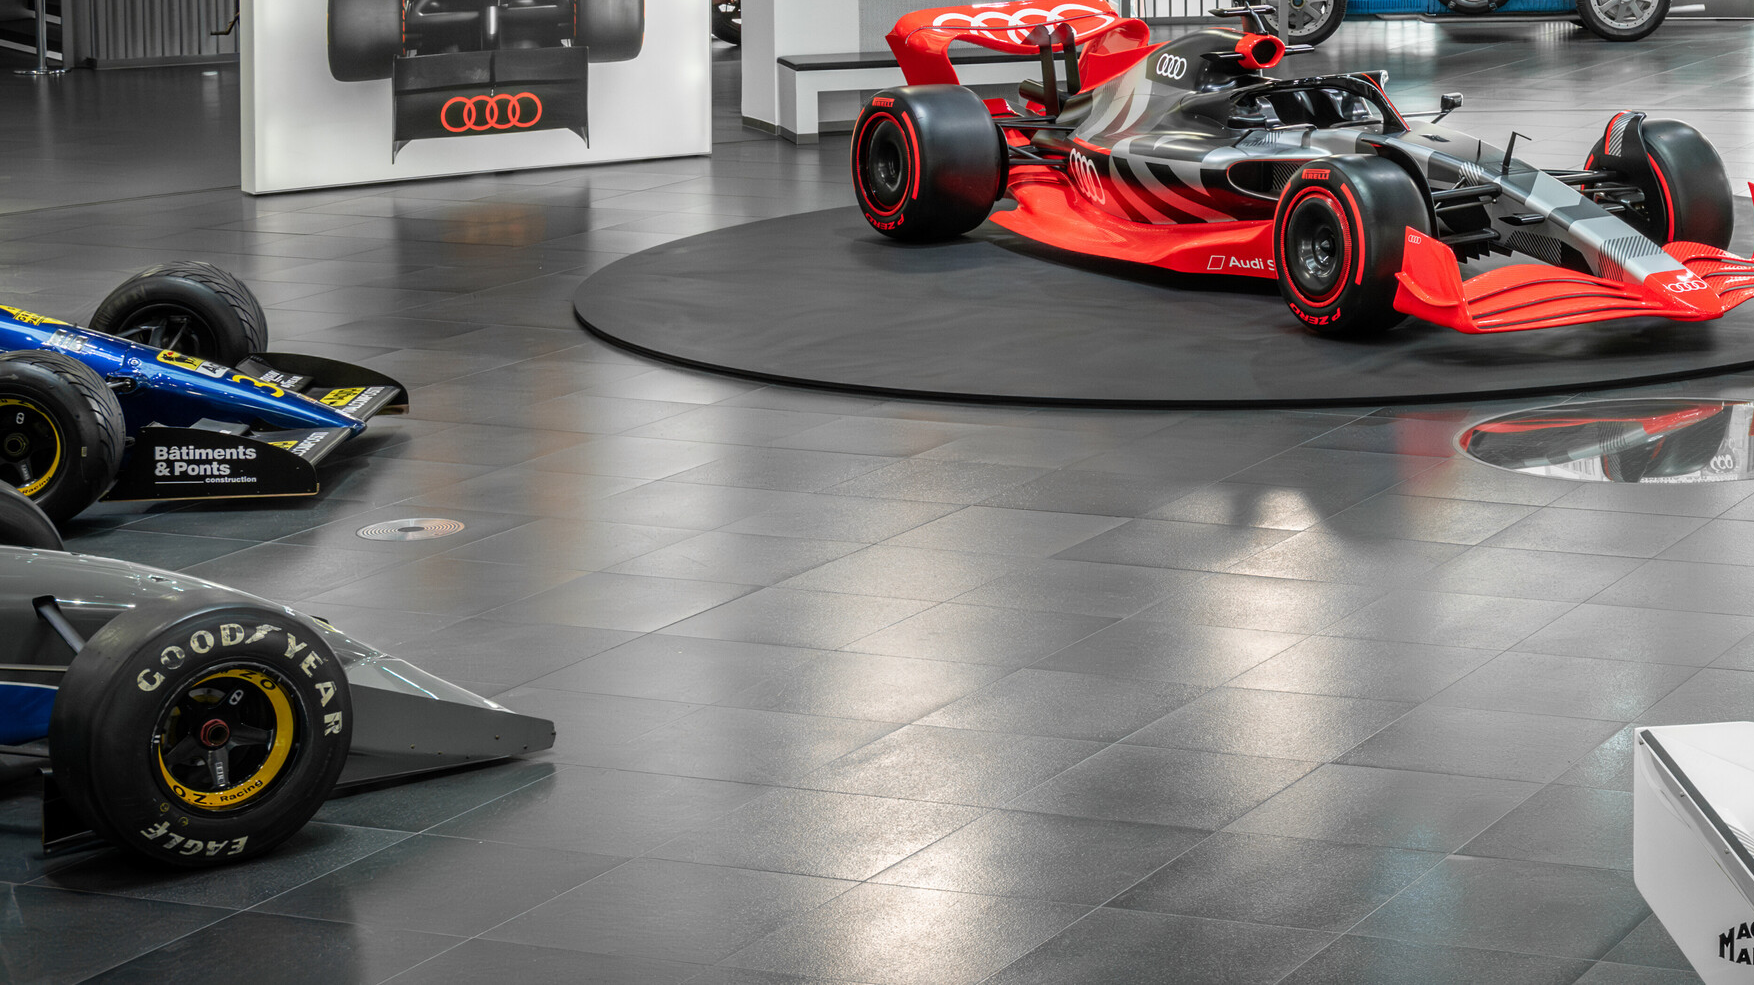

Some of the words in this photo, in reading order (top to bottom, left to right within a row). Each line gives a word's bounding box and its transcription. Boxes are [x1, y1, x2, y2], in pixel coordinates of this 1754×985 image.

[1302, 168, 1331, 180] PIRELLI
[1229, 256, 1263, 270] Audi
[1289, 302, 1330, 326] ZERO
[154, 445, 257, 460] Bâtiments
[154, 461, 171, 476] &
[174, 461, 231, 476] Ponts
[205, 475, 257, 483] construction
[220, 779, 264, 803] Racing
[139, 820, 249, 856] EAGLE
